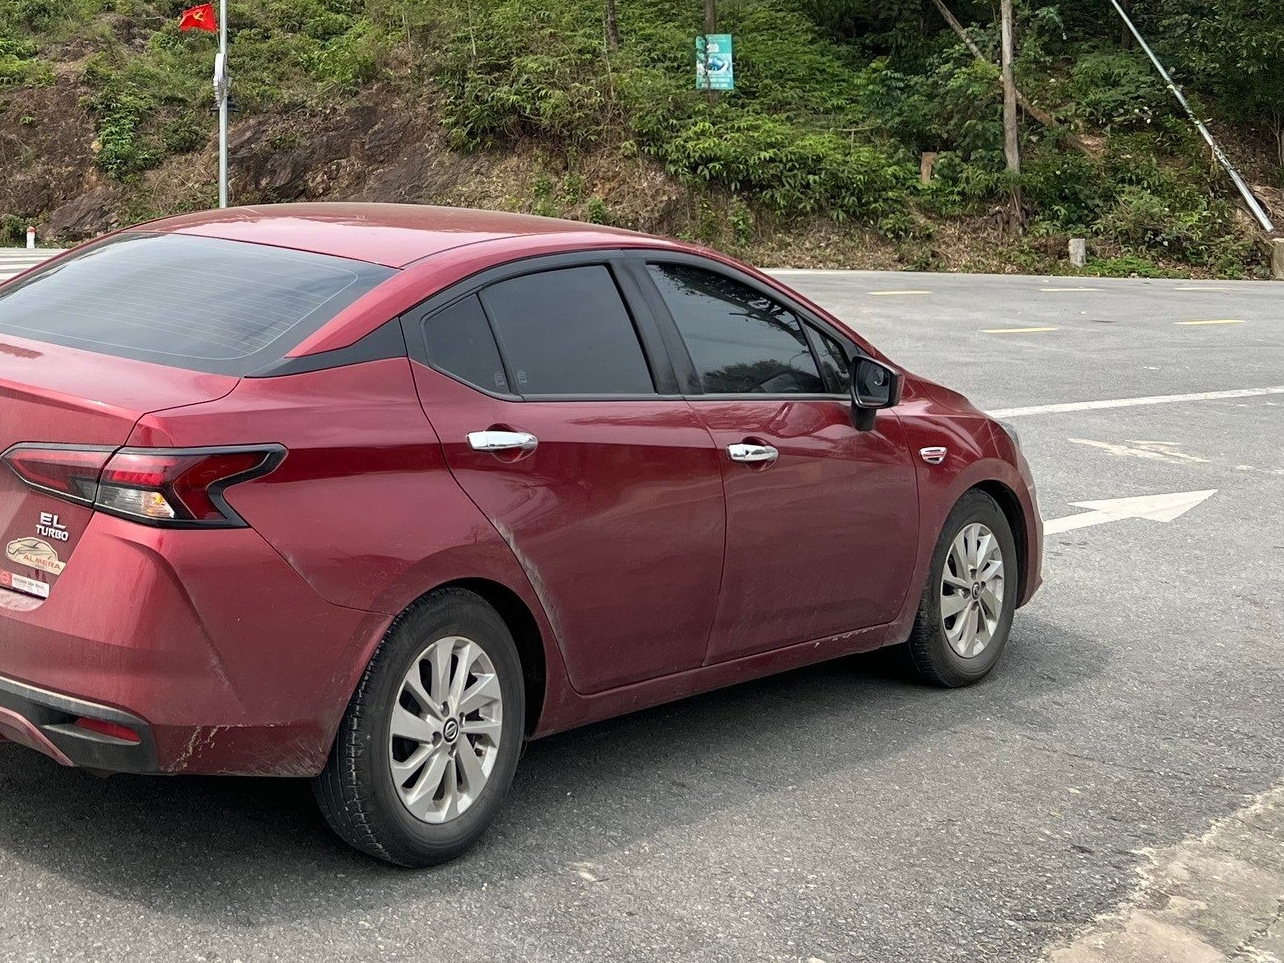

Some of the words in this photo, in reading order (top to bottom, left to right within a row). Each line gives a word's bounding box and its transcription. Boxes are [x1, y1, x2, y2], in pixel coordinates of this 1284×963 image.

[40, 511, 67, 529] EL
[35, 524, 69, 542] TURBO
[23, 554, 61, 570] ALMERA
